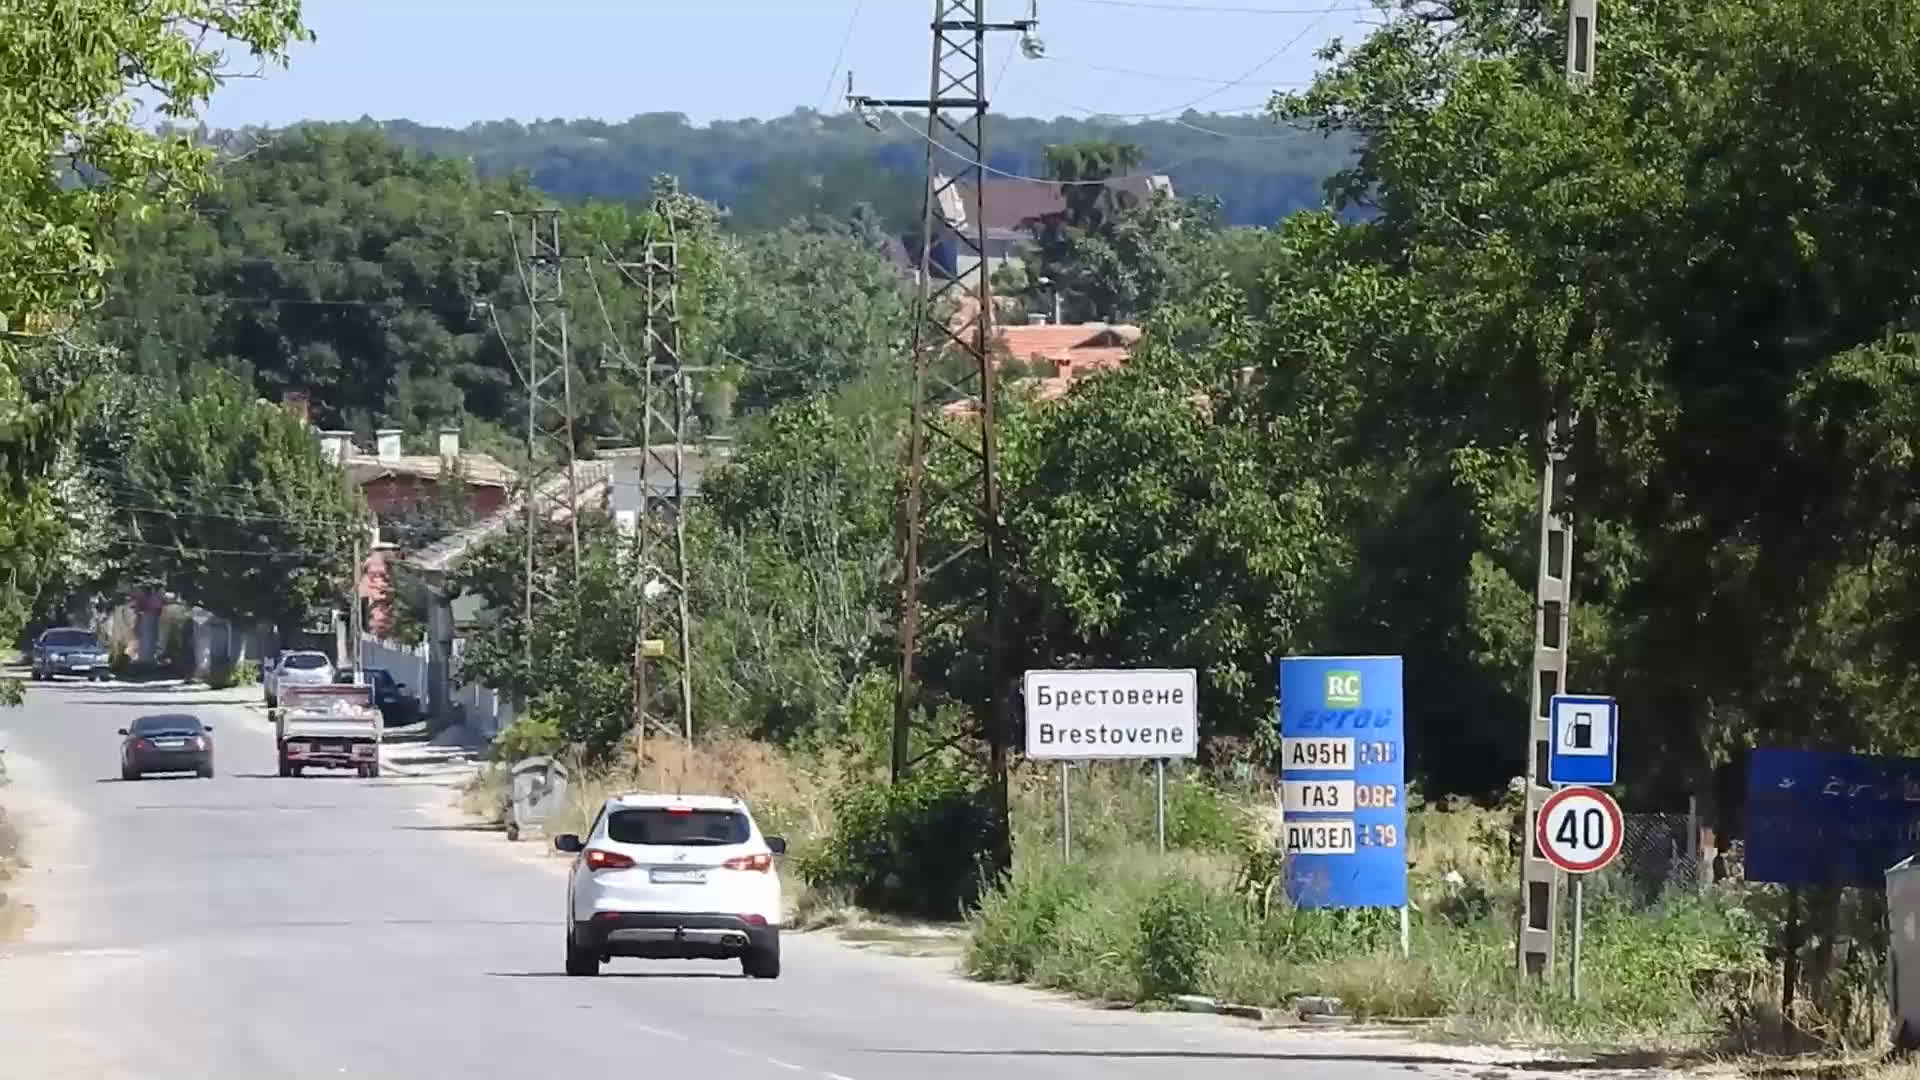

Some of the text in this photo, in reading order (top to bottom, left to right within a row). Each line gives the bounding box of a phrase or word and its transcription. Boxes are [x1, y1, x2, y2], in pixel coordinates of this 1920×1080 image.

[1327, 675, 1360, 696] RC
[1037, 685, 1184, 711] Брестовене
[1039, 723, 1184, 745] Brestovene
[1302, 785, 1339, 807] ГАЗ
[1288, 826, 1353, 852] ДИЗЕЛ
[1555, 807, 1605, 850] 40
